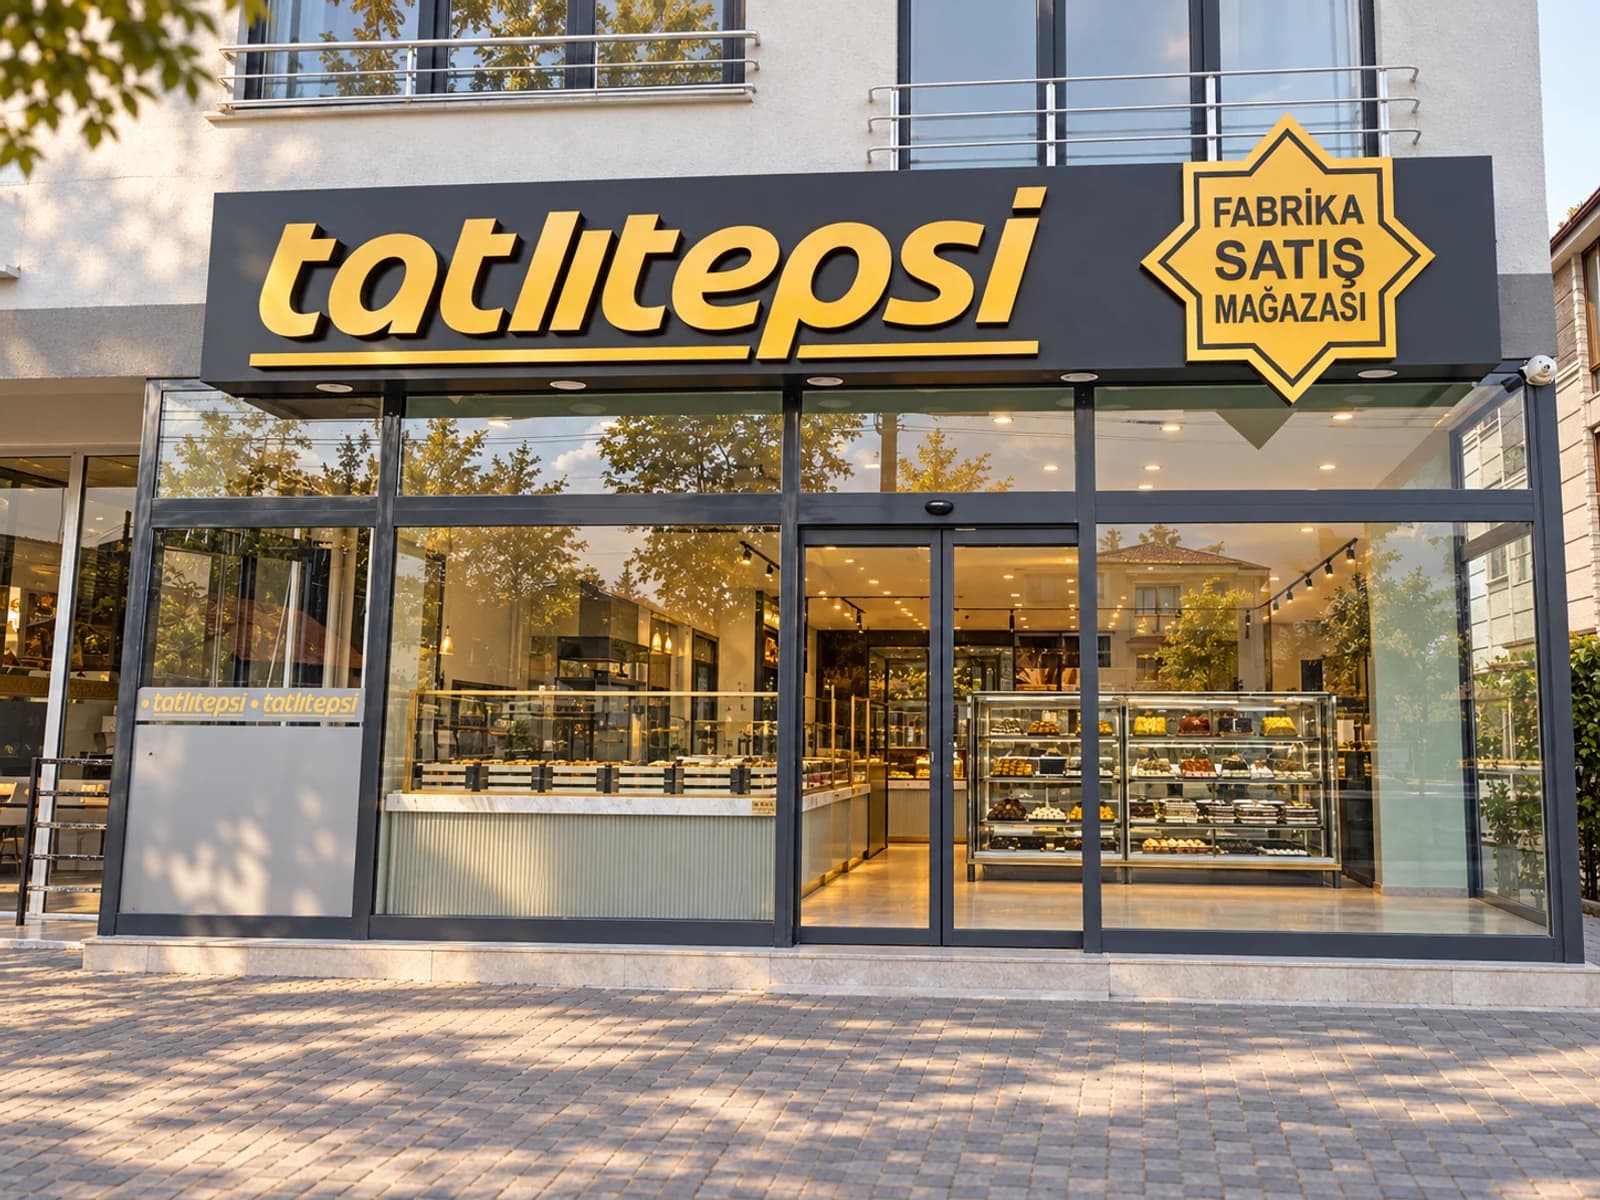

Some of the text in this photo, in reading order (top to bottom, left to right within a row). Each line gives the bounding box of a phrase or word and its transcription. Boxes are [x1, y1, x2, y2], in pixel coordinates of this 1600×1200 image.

[1213, 187, 1365, 228] FABRİKA
[259, 187, 1047, 360] tatlıtepsi
[1215, 237, 1365, 289] SATIŞ
[1215, 285, 1366, 324] MAĞAZASI
